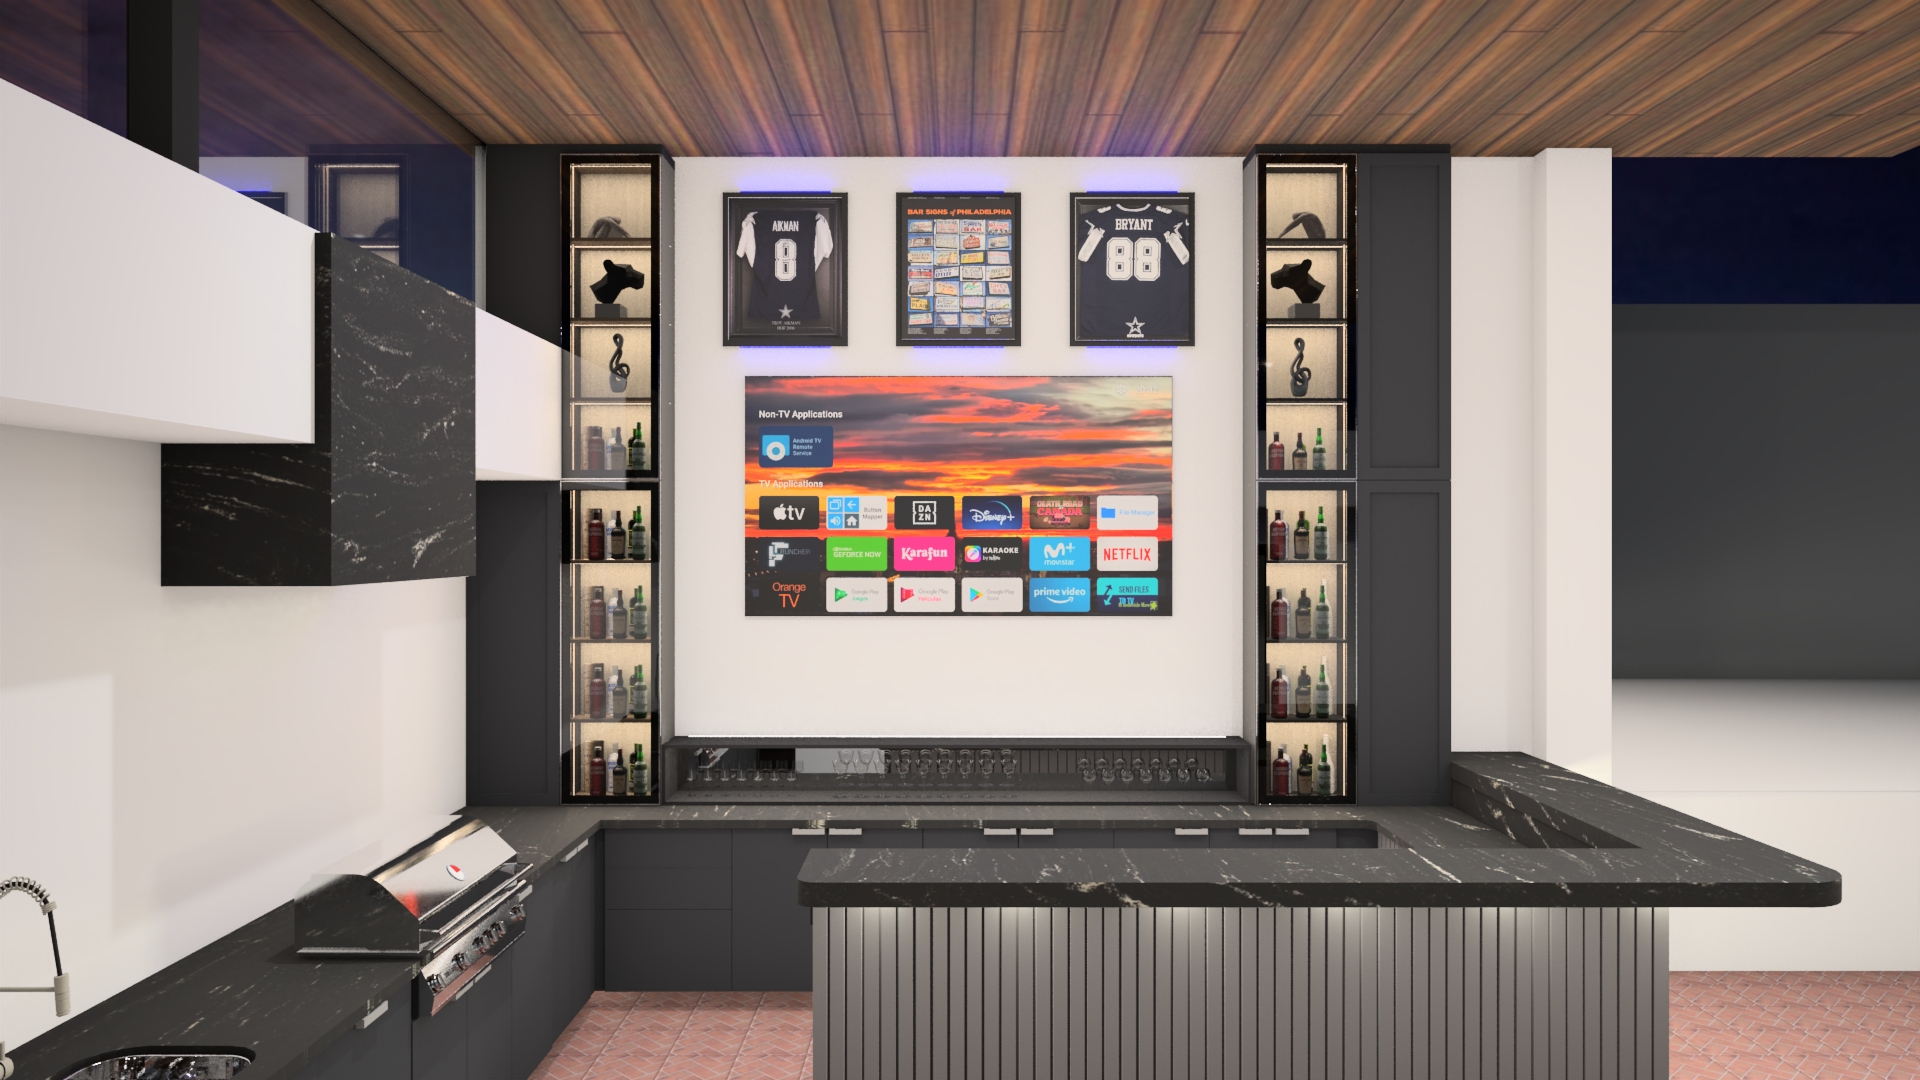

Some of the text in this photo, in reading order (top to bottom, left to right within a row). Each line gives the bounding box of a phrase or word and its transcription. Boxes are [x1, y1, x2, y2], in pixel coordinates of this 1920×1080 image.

[907, 208, 1012, 217] BAR SIGNS of PHILADELPHIA
[772, 220, 799, 232] AIKMAN
[1115, 218, 1153, 231] BRYANT
[774, 238, 797, 282] 8
[1106, 236, 1161, 282] 88
[1134, 385, 1159, 394] 20:32
[758, 410, 843, 420] Non-TV Applications
[758, 480, 824, 489] TV Applications
[918, 504, 932, 513] DA
[1036, 500, 1060, 508] DEATH
[1062, 500, 1083, 508] ROAD
[787, 505, 806, 521] tv
[862, 513, 883, 521] Mapper
[918, 513, 932, 521] ZN
[1036, 507, 1083, 517] CANADA
[1131, 509, 1155, 517] Manager
[901, 547, 948, 561] Karafun
[1103, 547, 1151, 562] NETFLIX
[1044, 558, 1075, 566] movistar
[772, 582, 806, 594] Orange
[918, 588, 949, 596] Google Play
[986, 588, 1003, 596] Google
[1034, 587, 1086, 597] prime video
[778, 593, 800, 609] TV
